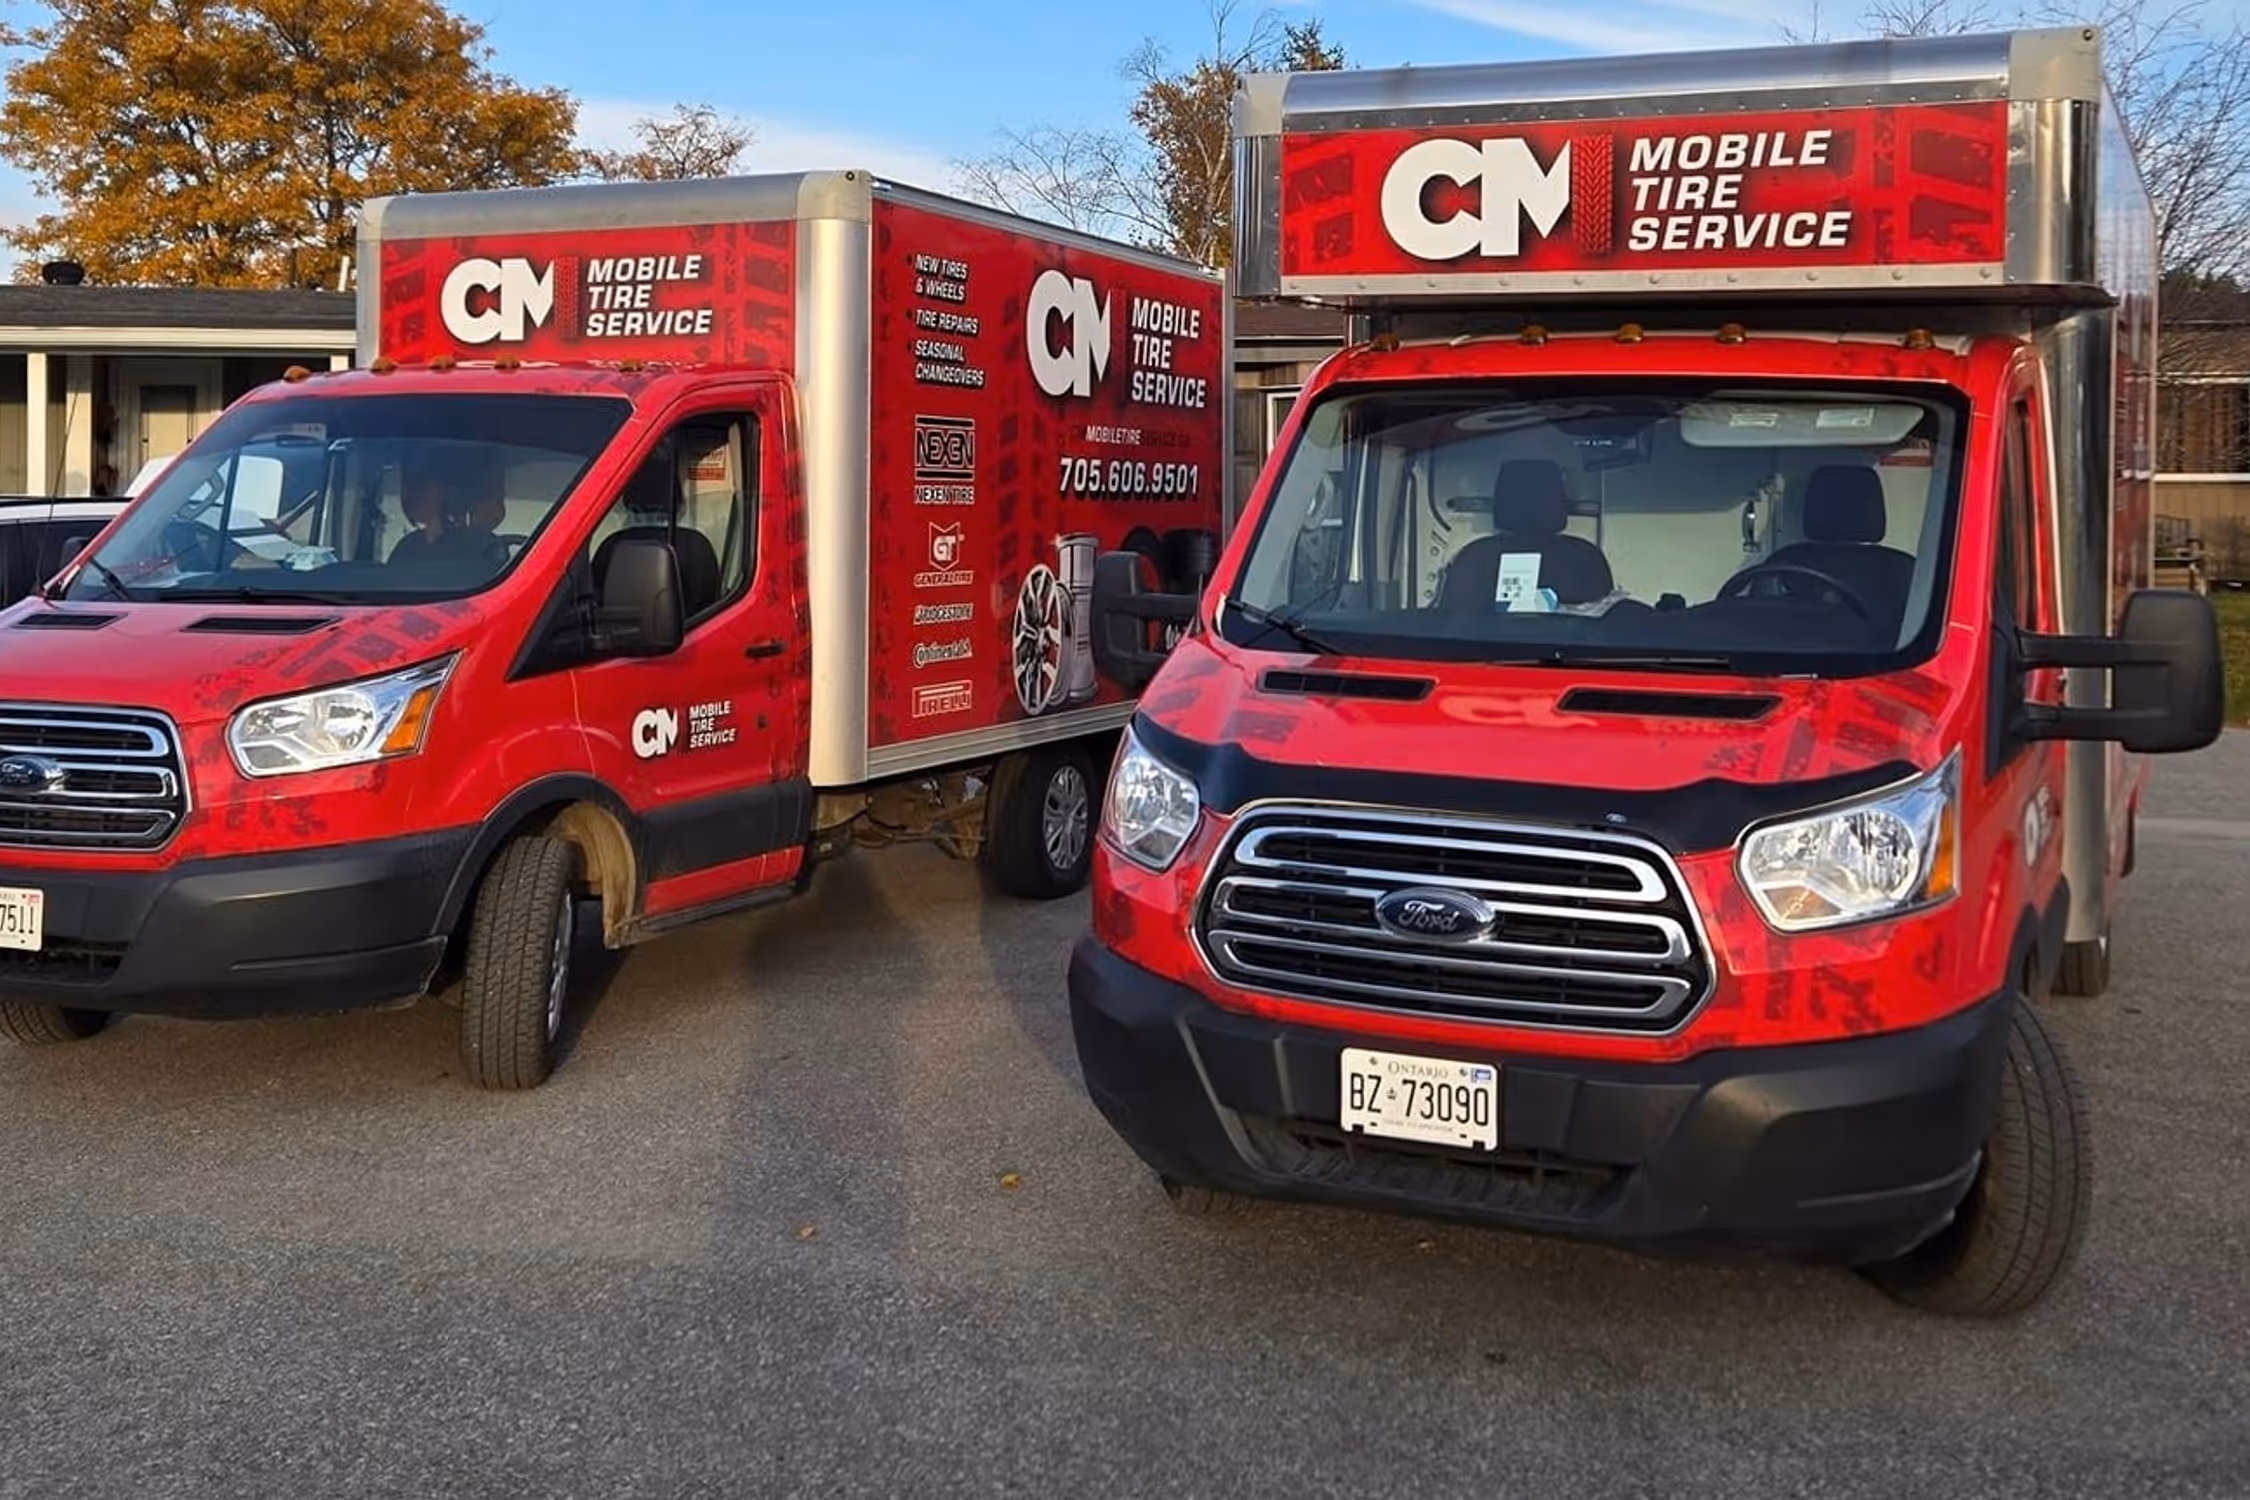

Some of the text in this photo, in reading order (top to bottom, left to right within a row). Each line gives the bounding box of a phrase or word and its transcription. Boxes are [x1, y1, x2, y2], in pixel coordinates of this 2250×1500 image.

[1628, 129, 1833, 172] MOBILE
[1381, 137, 1570, 260] CM
[1630, 173, 1743, 211] TIRE
[1628, 211, 1852, 251] SERVICE
[586, 254, 702, 283] MOBILE
[915, 254, 968, 280] NEW TIRES
[441, 258, 554, 343] CM
[587, 284, 652, 310] TIRE
[926, 279, 965, 301] WHEELS
[586, 309, 713, 337] SERVICE
[916, 309, 979, 334] TIRE REPAIRS
[1026, 269, 1111, 397] CM
[1132, 297, 1200, 338] MOBILE
[915, 339, 965, 362] SEASONAL
[1132, 333, 1172, 369] TIRE
[915, 363, 985, 387] CHANGEOVERS
[1131, 370, 1206, 408] SERVICE
[915, 427, 975, 468] NEXEN
[1059, 456, 1198, 495] 705.606.9501
[915, 485, 975, 505] NEXEN TIRE
[689, 700, 732, 719] MOBILE
[689, 718, 715, 733] TIRE
[632, 708, 678, 758] CM
[689, 728, 736, 748] SERVICE
[1398, 900, 1460, 932] Ford
[1350, 1072, 1489, 1127] BZ 73090
